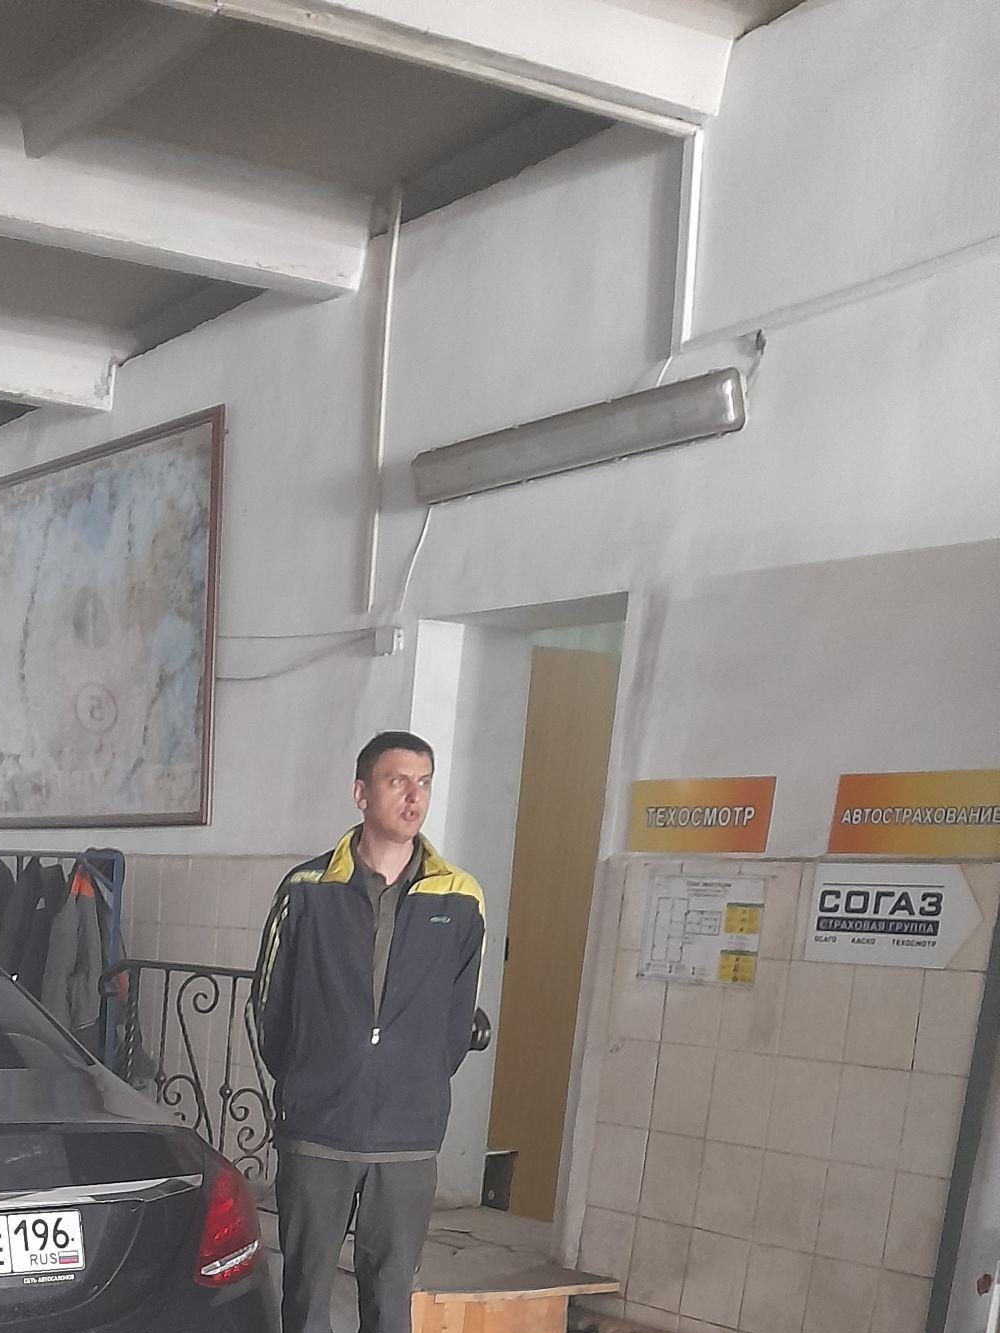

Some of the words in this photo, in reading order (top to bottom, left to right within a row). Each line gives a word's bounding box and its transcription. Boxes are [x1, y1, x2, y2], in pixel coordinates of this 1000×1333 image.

[647, 806, 756, 827] ТЕХОСМОТР
[841, 806, 1000, 825] АВТОСТРАХОВАНИЕ
[818, 890, 944, 917] СОГАЗ
[819, 919, 885, 931] СТРАХОВАЯ
[888, 922, 934, 933] ГРУППА
[13, 1217, 70, 1251] 196
[30, 1252, 58, 1266] RUS
